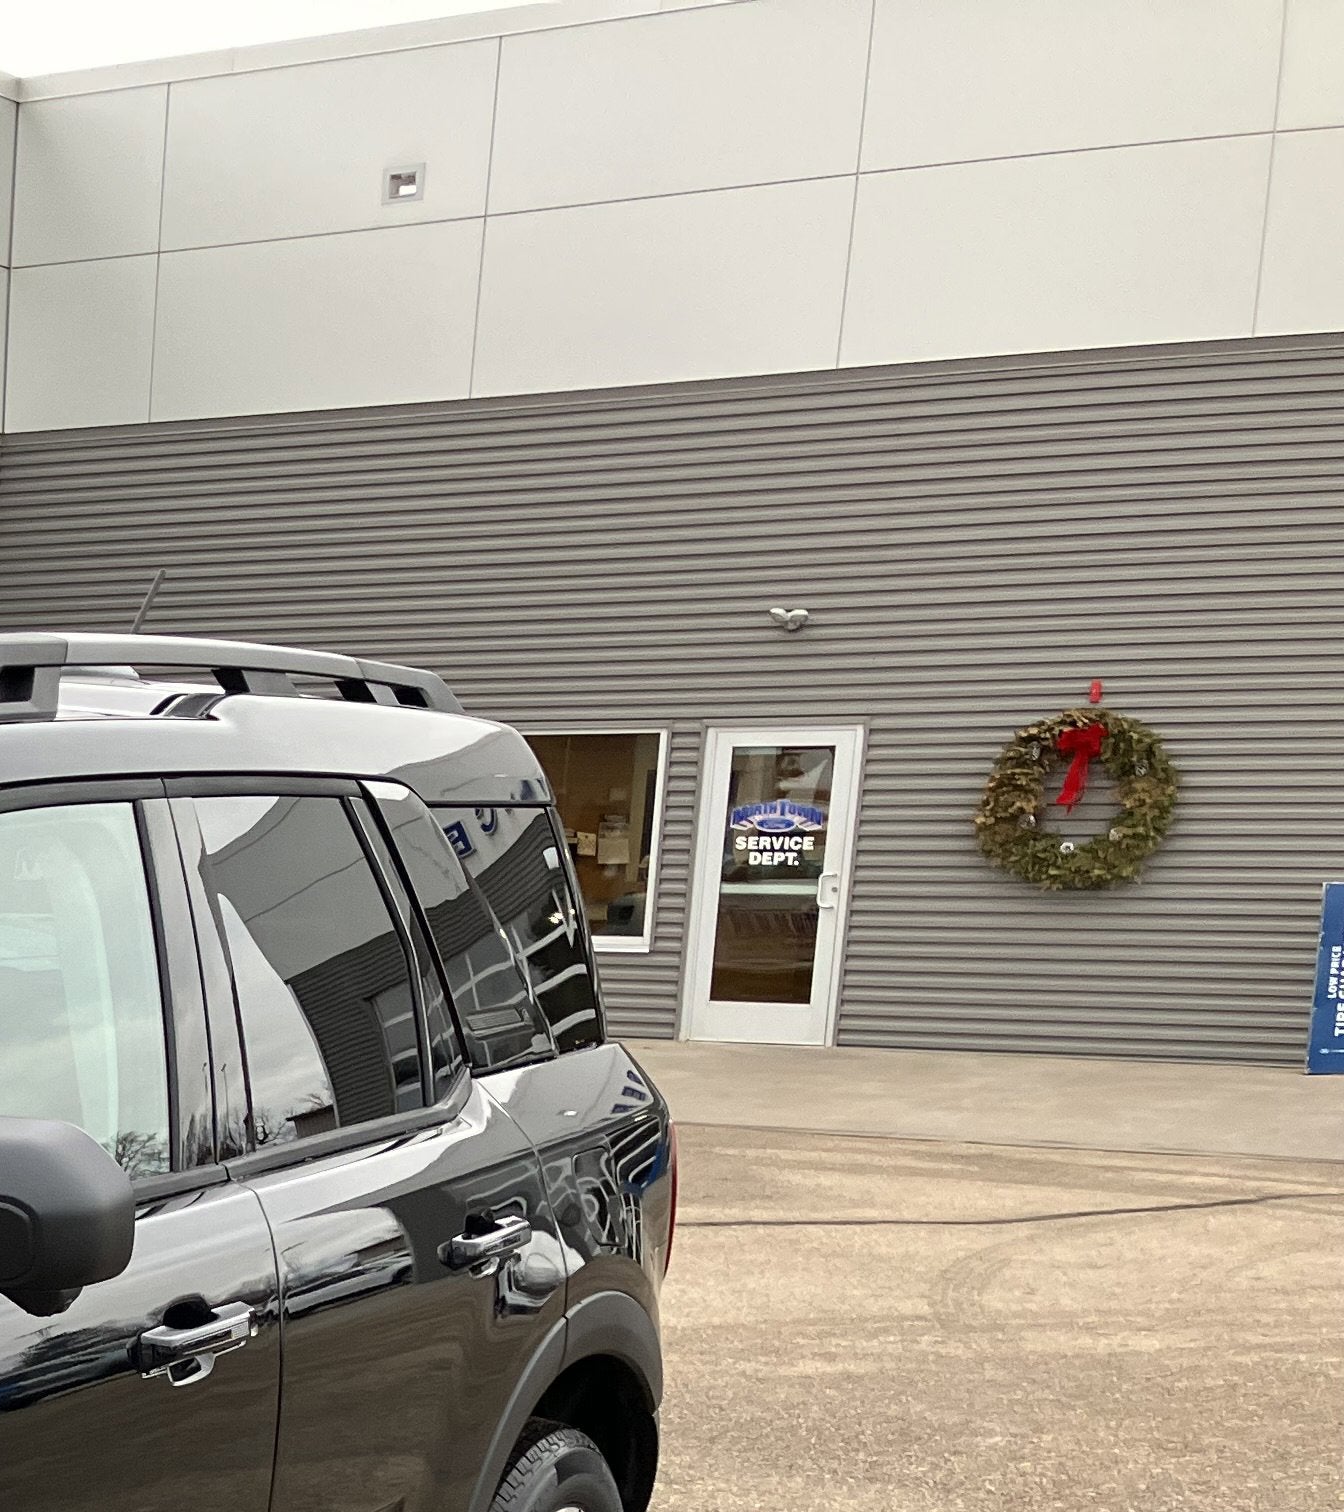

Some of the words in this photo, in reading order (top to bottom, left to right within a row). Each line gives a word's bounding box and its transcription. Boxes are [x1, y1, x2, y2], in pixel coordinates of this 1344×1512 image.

[735, 836, 815, 851] SERVICE
[748, 851, 800, 866] DEPT.
[1328, 944, 1343, 975] PRICE
[1326, 976, 1339, 999] LOW
